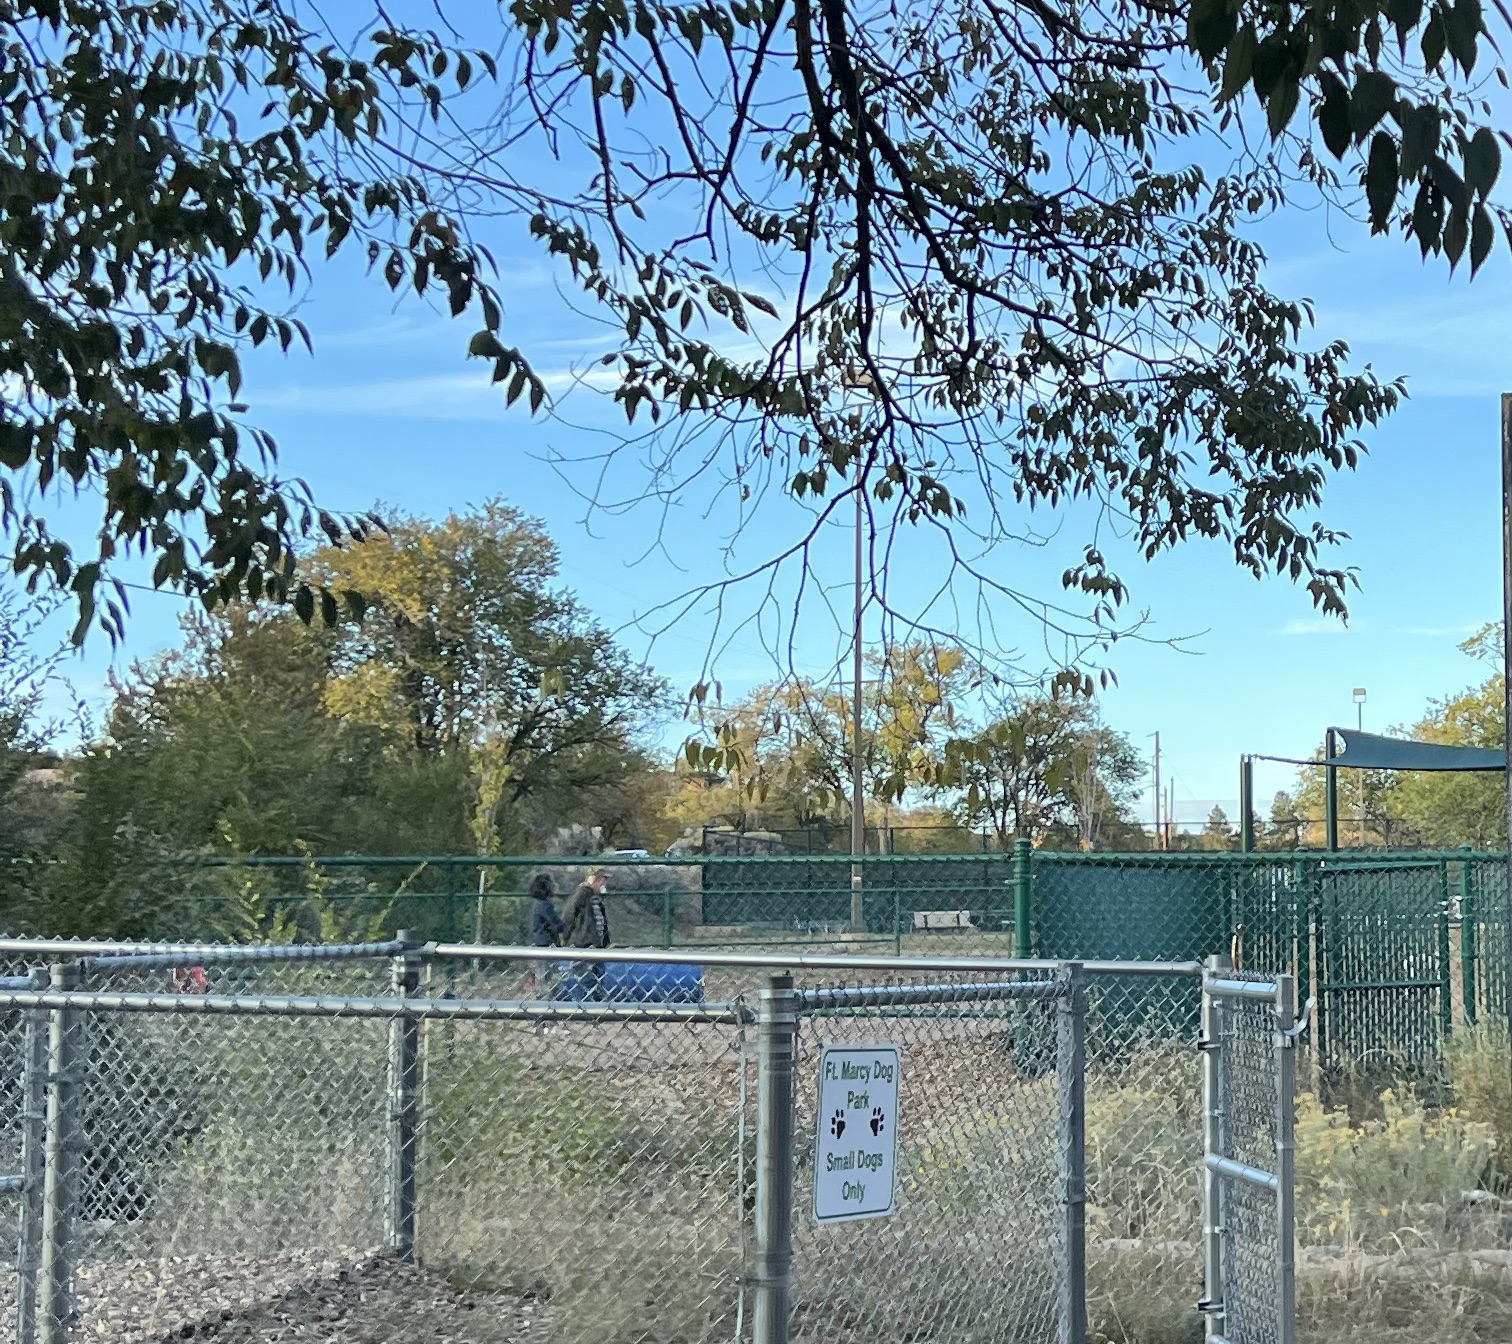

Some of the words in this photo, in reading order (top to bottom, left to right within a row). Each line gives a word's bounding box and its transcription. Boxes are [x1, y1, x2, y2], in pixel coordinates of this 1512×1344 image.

[841, 1061, 870, 1084] Marcy
[873, 1060, 894, 1084] Dog
[847, 1090, 870, 1110] Park
[826, 1151, 854, 1173] Small
[857, 1149, 884, 1173] Dogs
[841, 1180, 866, 1204] Only
